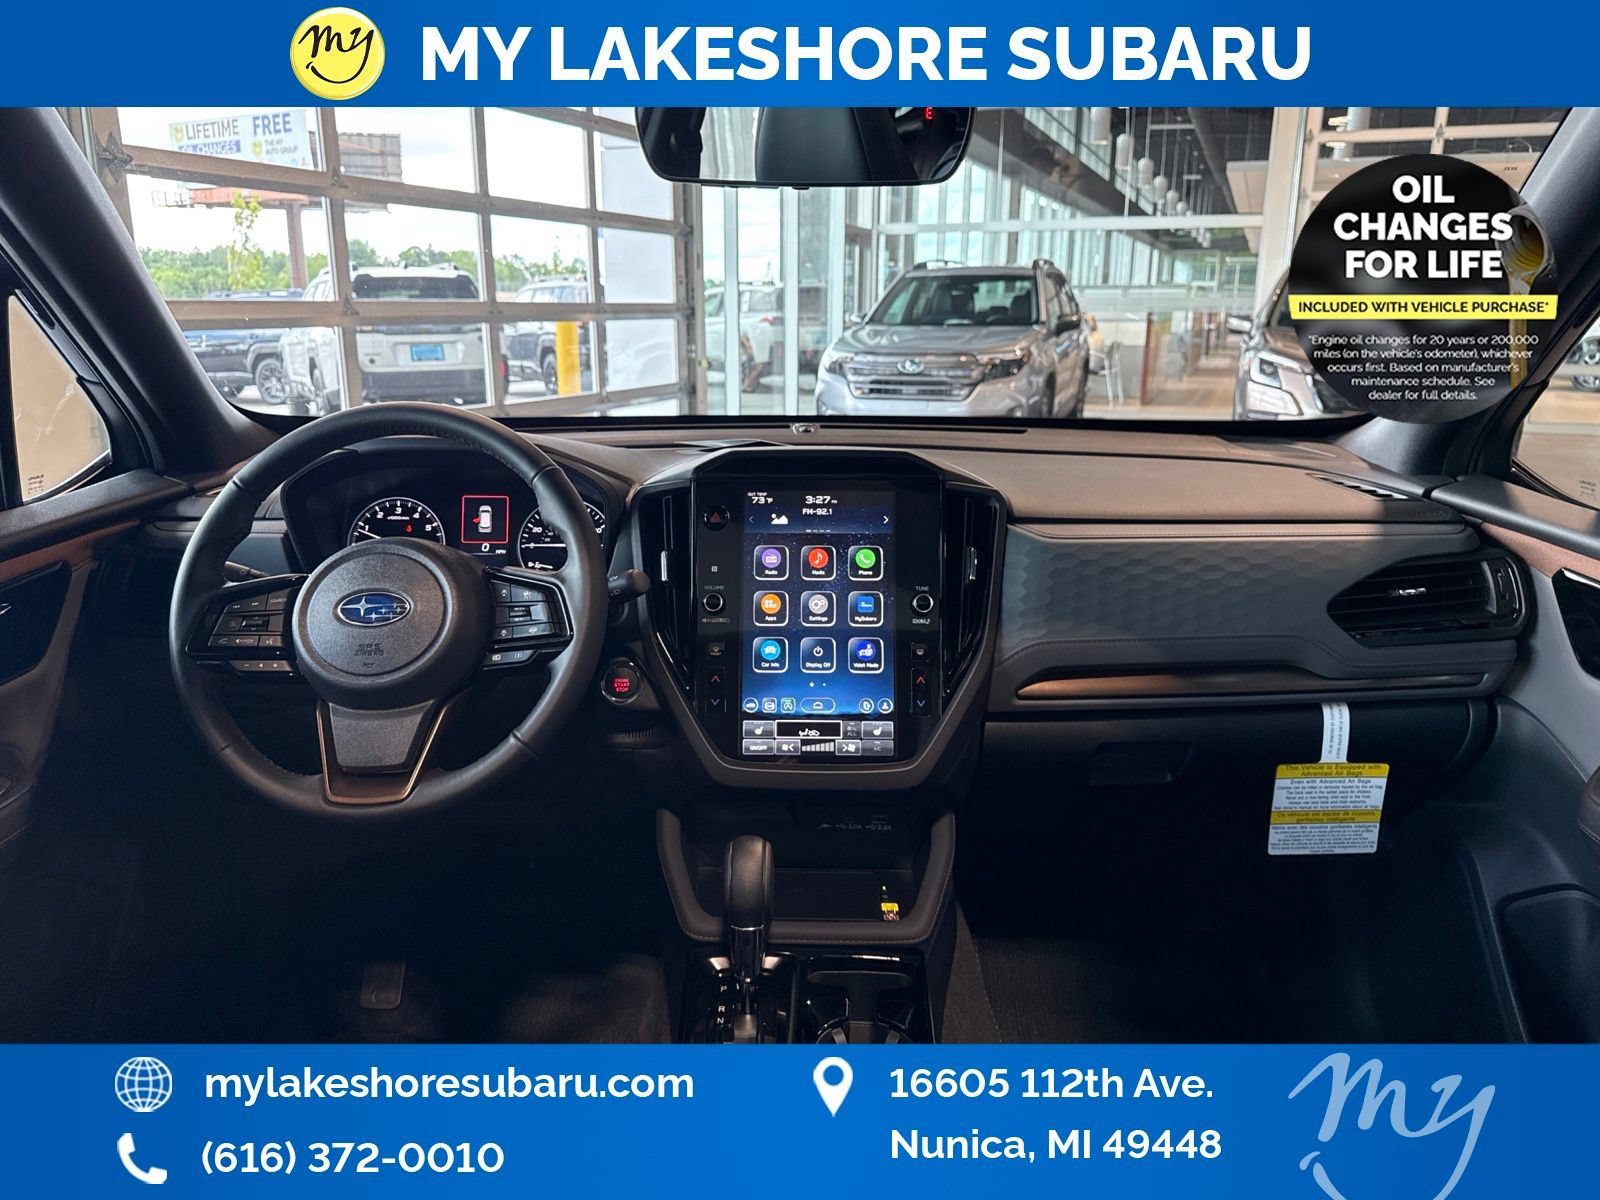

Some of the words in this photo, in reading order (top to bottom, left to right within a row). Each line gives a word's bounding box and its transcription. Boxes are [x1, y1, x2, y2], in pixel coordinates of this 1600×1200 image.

[252, 112, 292, 137] FREE
[185, 119, 240, 141] LIFETIME
[805, 496, 831, 504] 3:27
[376, 511, 384, 519] 2
[718, 1005, 726, 1013] R
